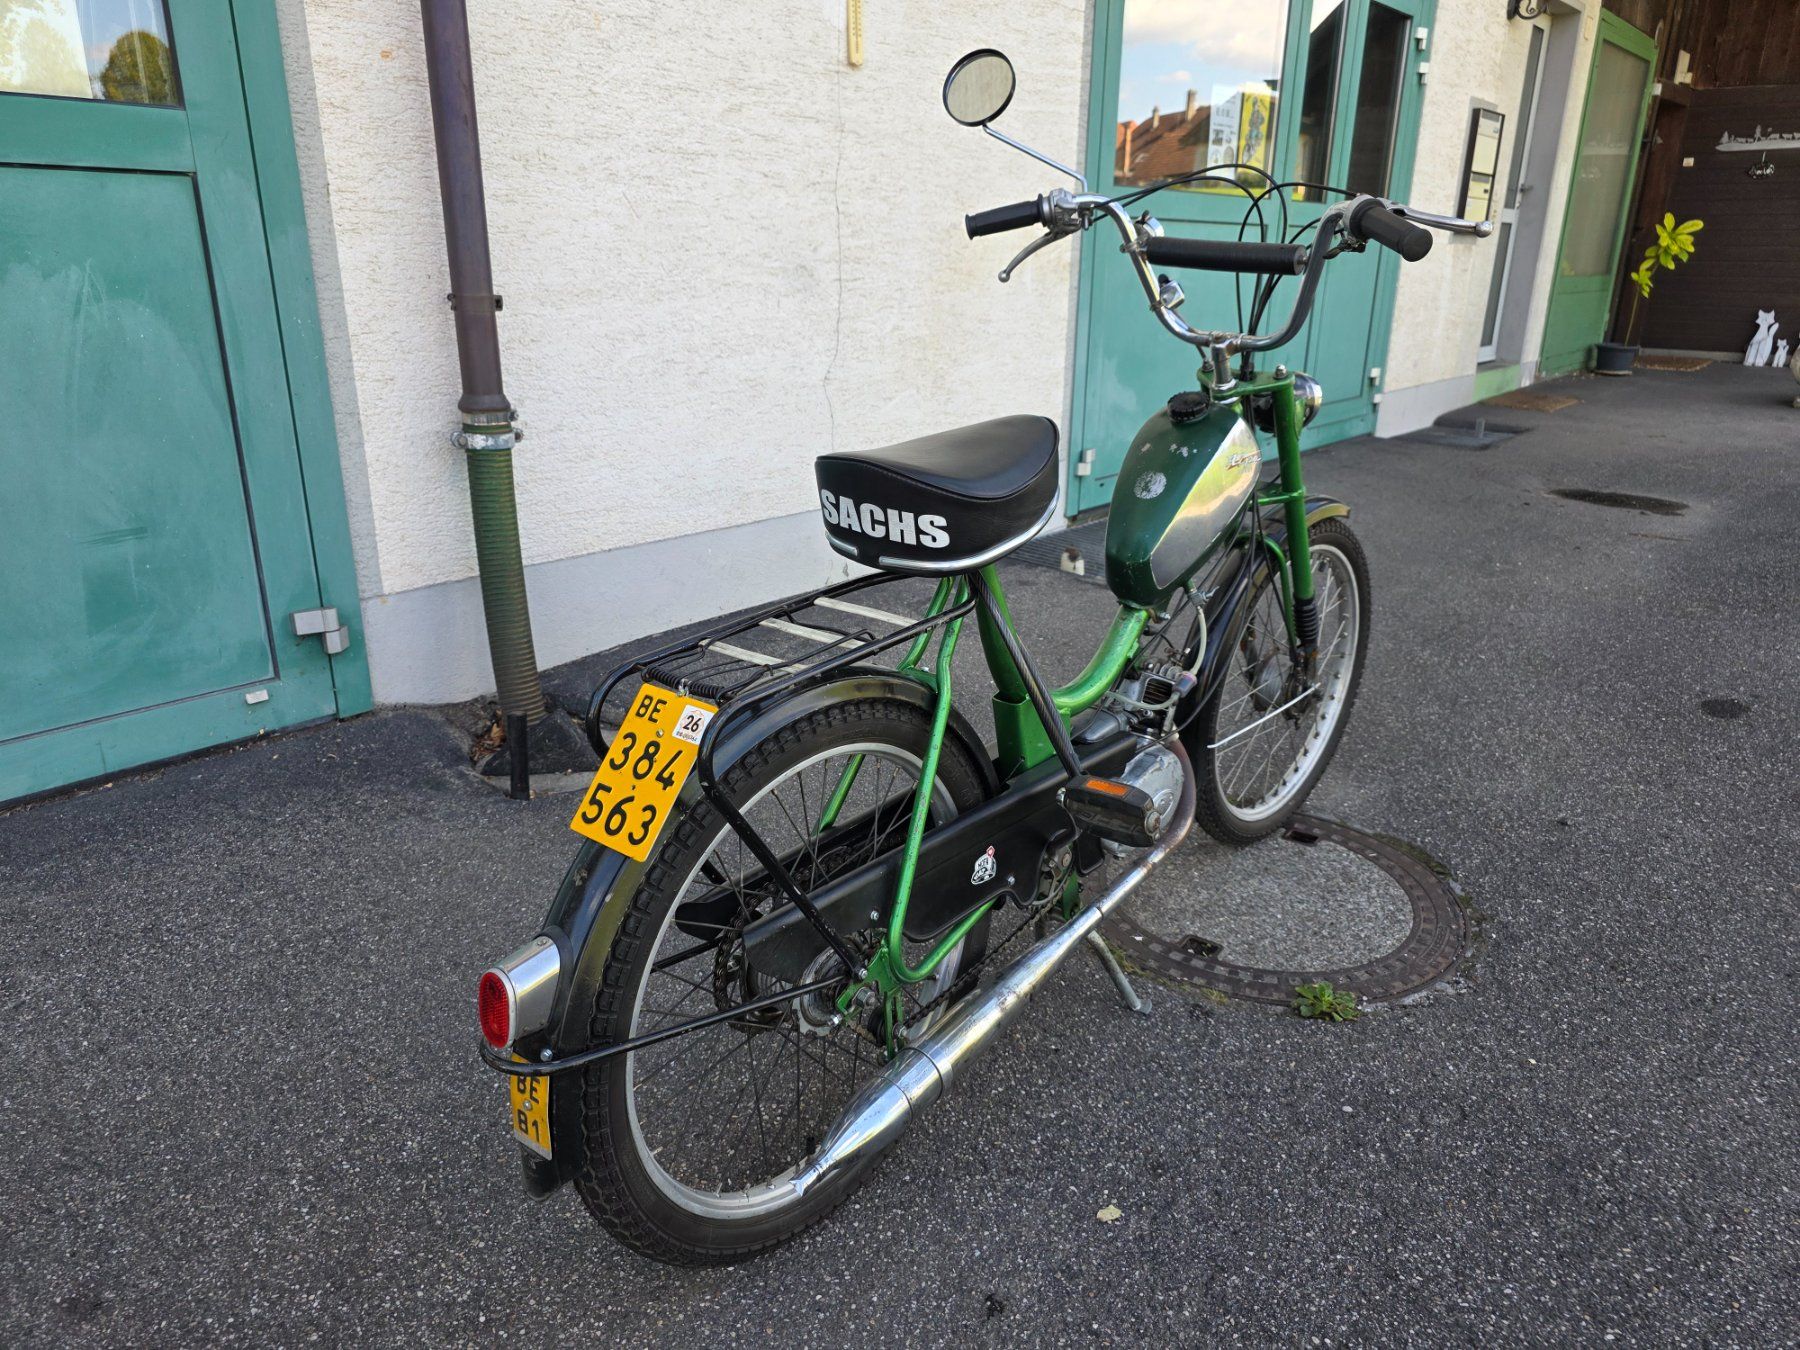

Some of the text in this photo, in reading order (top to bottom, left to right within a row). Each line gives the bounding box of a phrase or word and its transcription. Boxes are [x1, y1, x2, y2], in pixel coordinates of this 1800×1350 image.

[821, 489, 950, 548] SACHS
[635, 694, 667, 723] BE
[682, 714, 702, 732] 26
[609, 732, 683, 791] 384
[581, 783, 657, 846] 563
